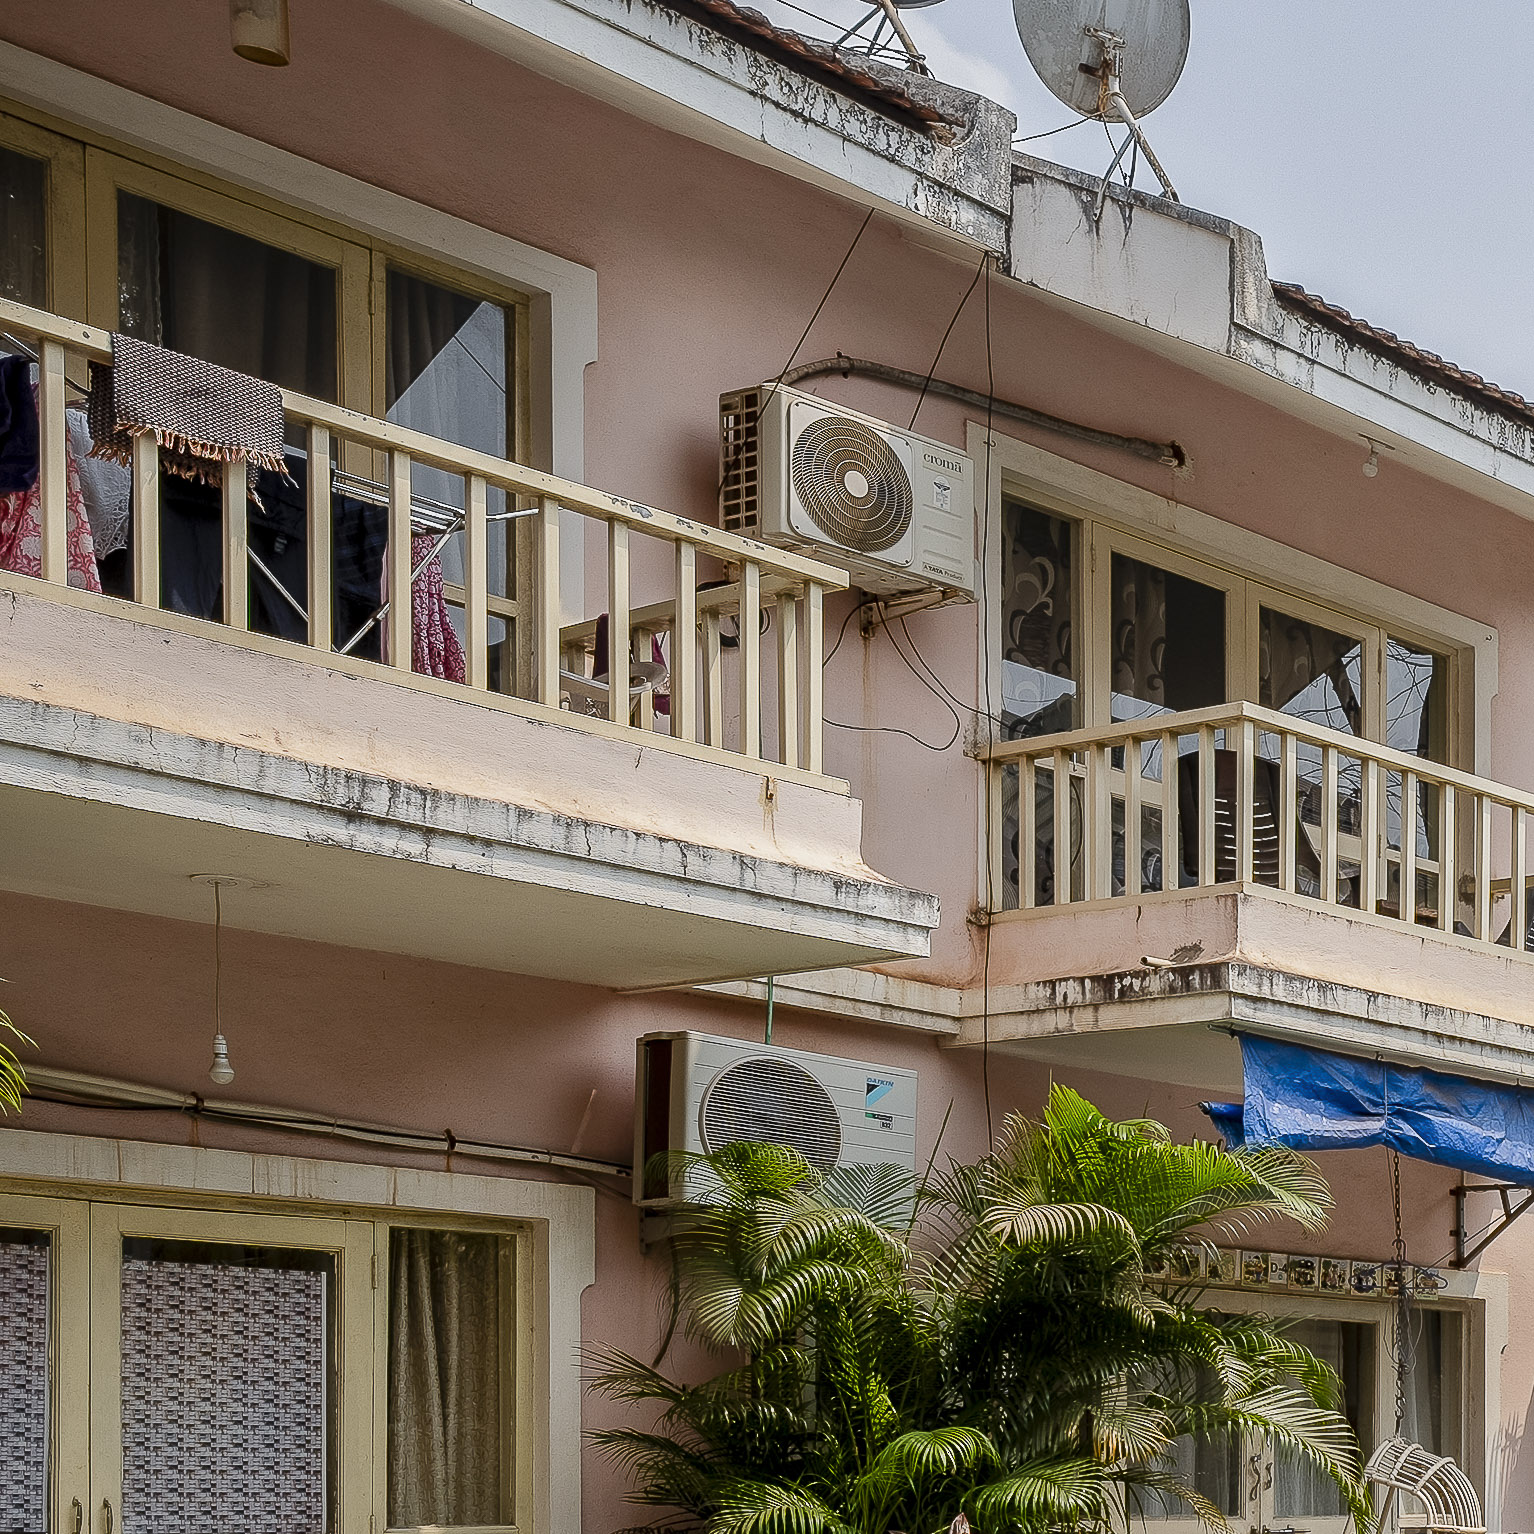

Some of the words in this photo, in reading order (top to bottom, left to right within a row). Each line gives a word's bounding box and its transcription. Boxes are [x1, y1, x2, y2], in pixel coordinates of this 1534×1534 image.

[929, 565, 944, 575] TATA
[944, 570, 963, 581] Product
[866, 1077, 895, 1087] DAIKIN
[1271, 1262, 1288, 1274] D-4
